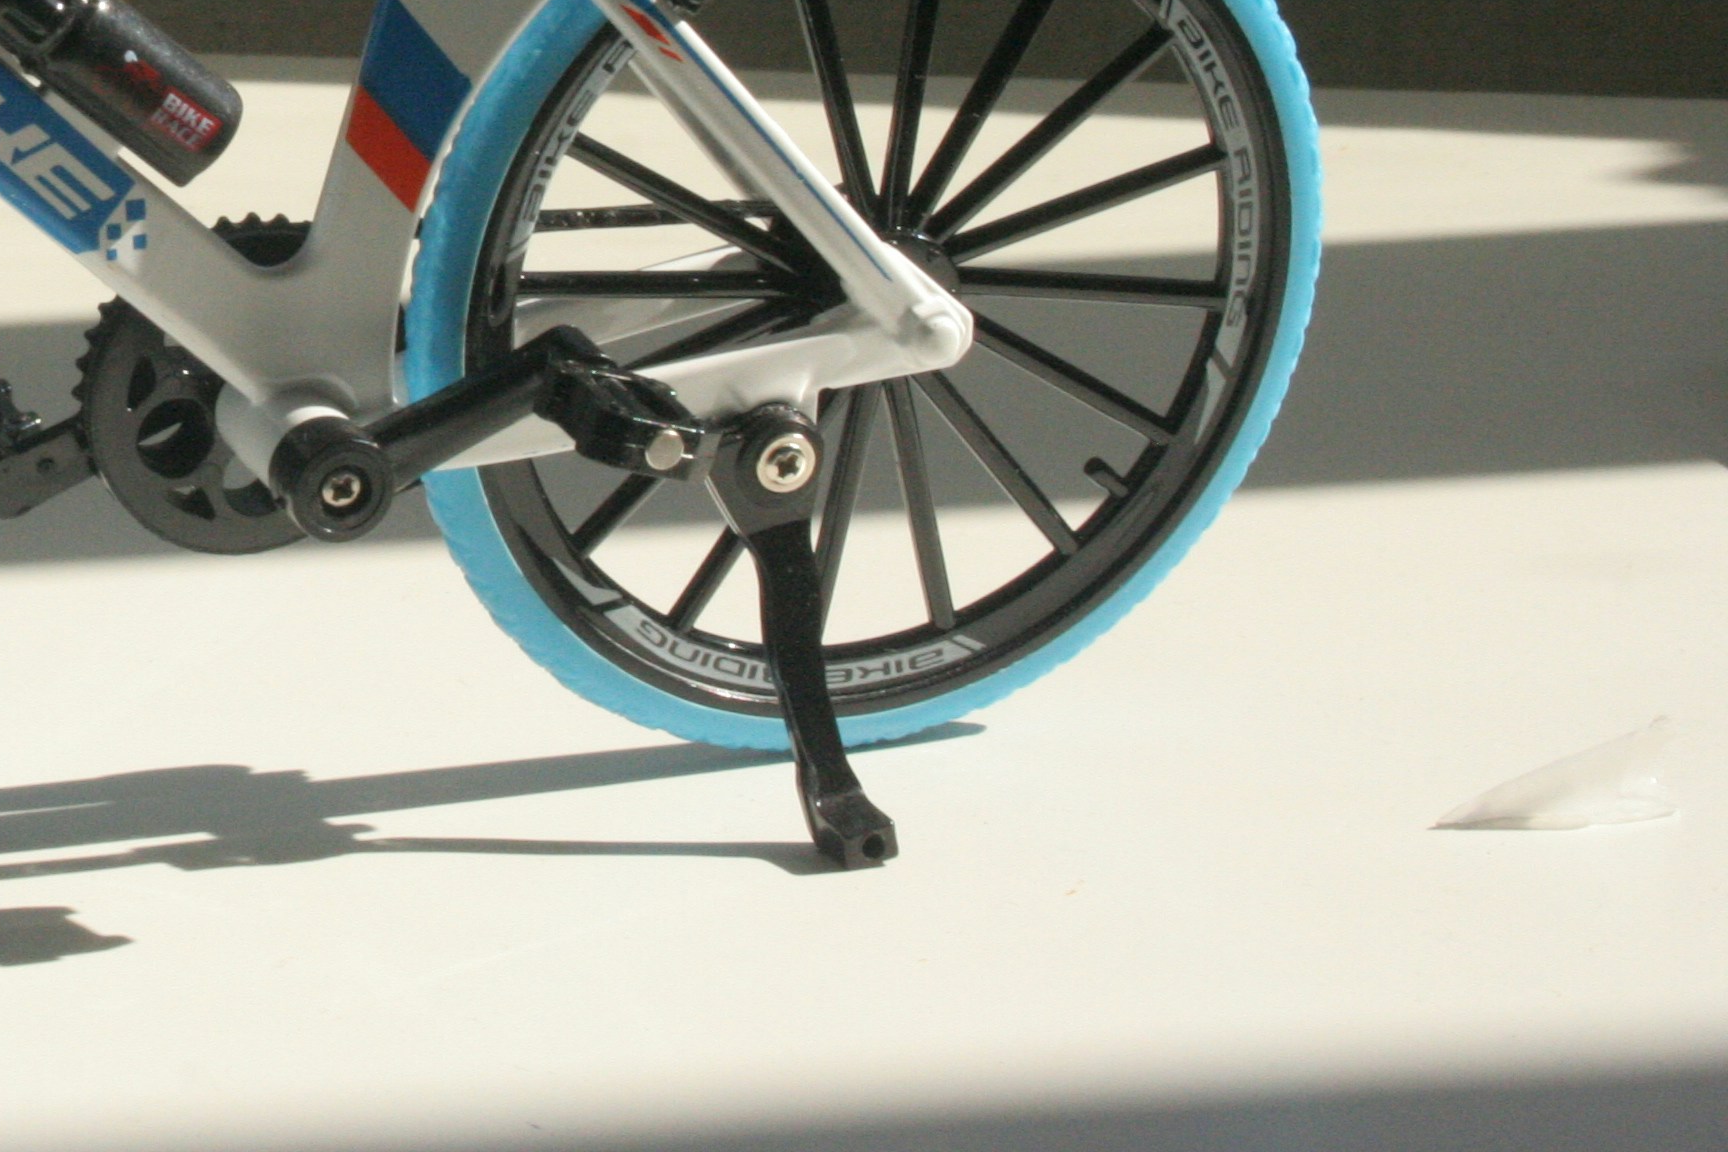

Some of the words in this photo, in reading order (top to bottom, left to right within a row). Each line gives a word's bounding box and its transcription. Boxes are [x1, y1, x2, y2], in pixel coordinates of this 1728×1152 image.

[151, 107, 202, 148] RACE
[162, 92, 216, 137] BIKE
[522, 88, 595, 223] BIKE
[1177, 18, 1238, 129] BIKE
[1226, 148, 1254, 326] RIDING
[825, 649, 945, 682] BIKE
